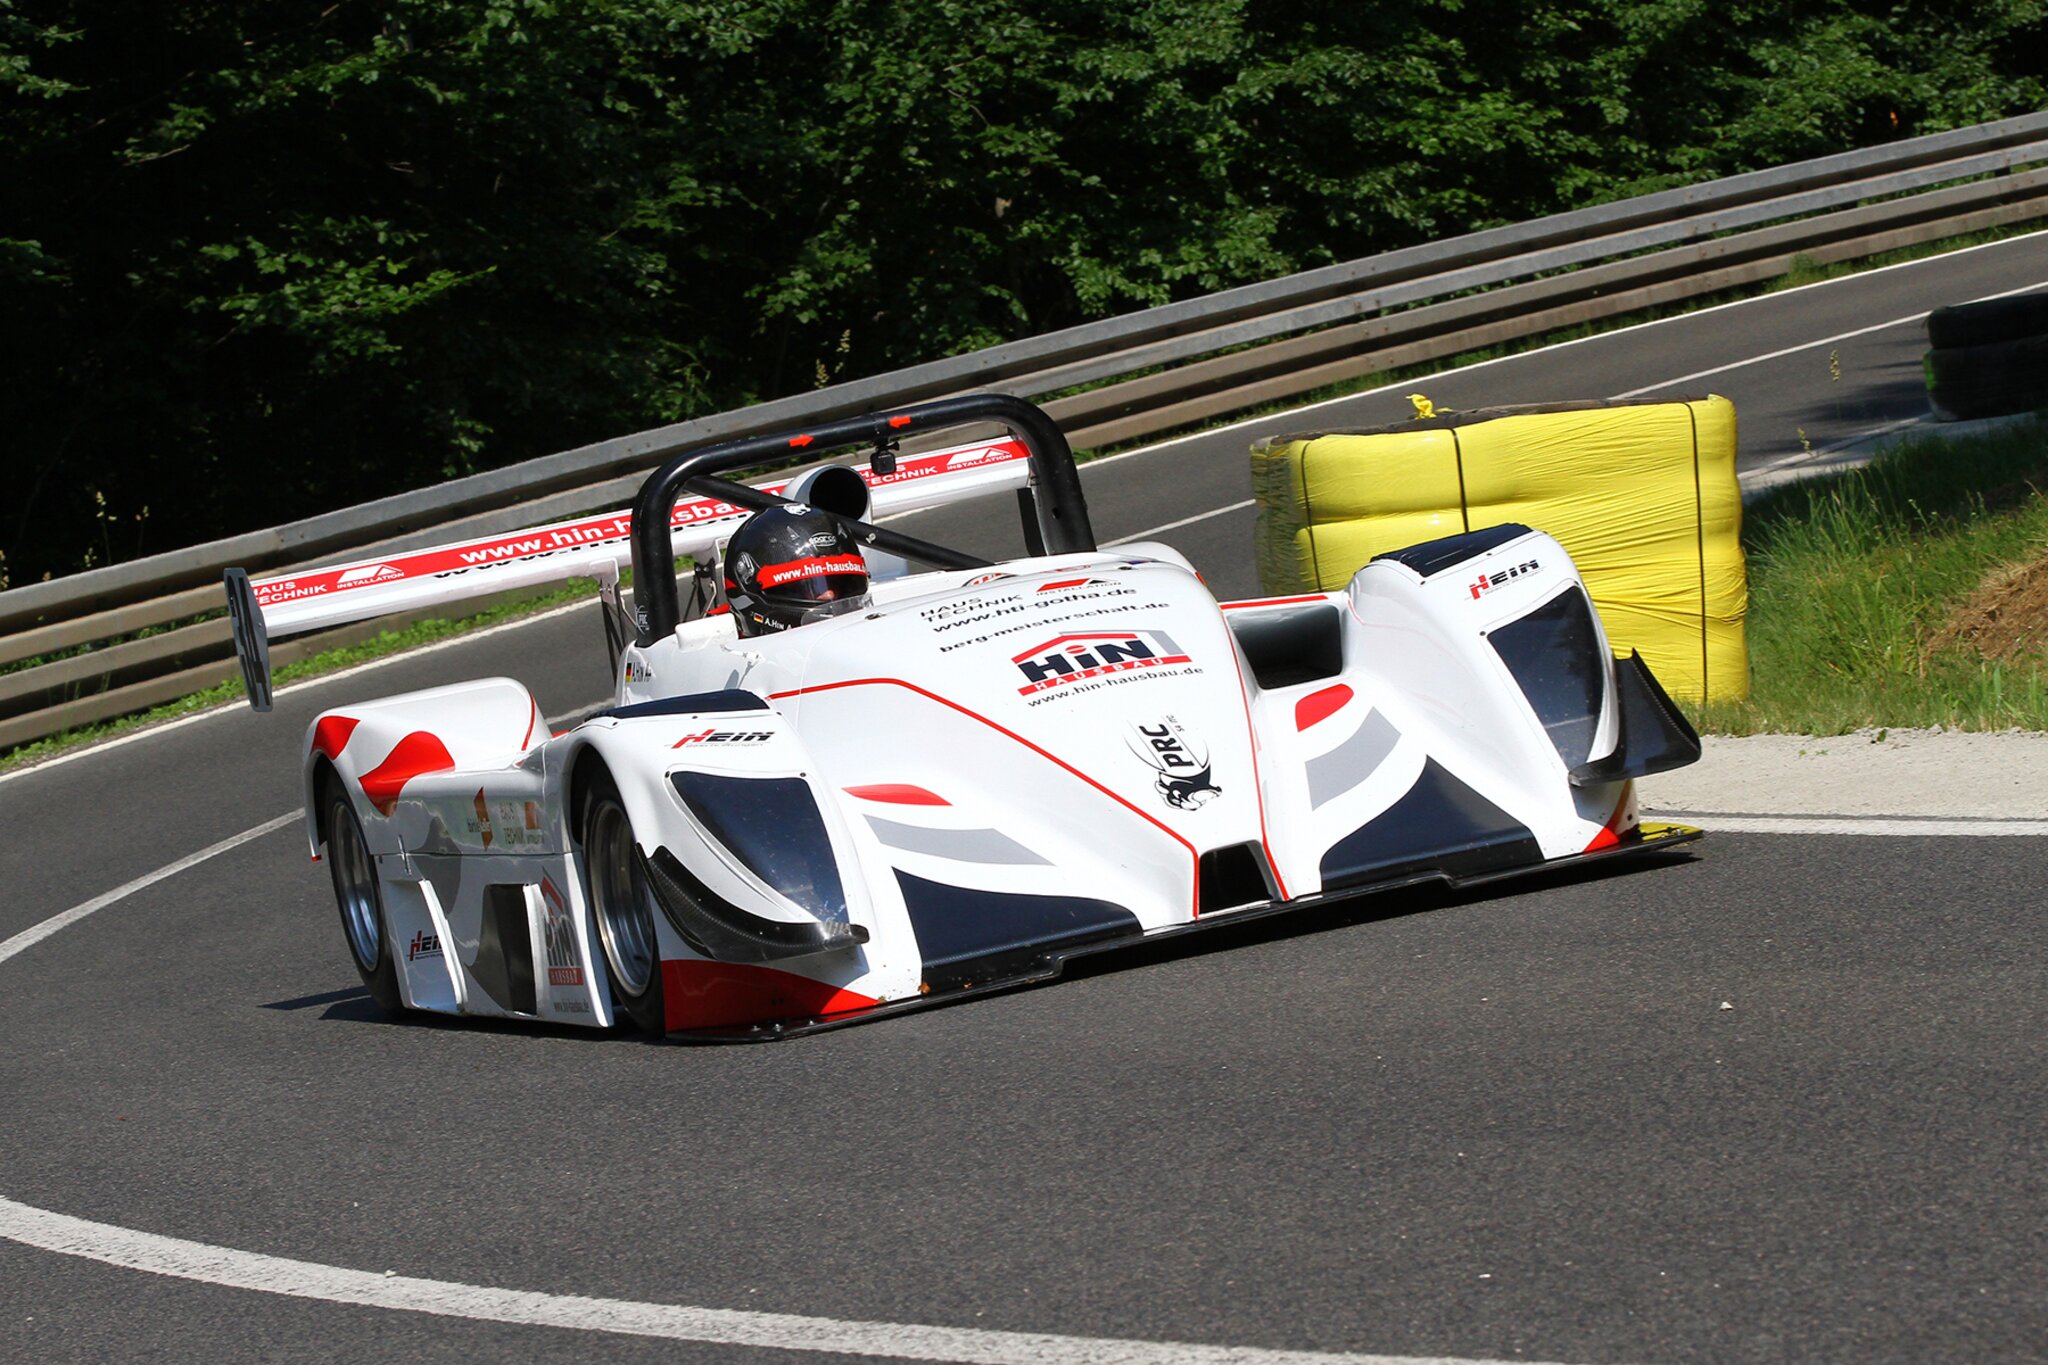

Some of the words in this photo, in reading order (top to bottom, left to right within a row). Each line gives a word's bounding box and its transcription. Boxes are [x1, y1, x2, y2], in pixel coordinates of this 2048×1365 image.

[946, 453, 1013, 471] INSTALLATION
[331, 571, 405, 590] INSTALLATION
[1036, 580, 1122, 596] INSTALLATION
[920, 597, 982, 618] HAUS
[924, 594, 1023, 623] TECHNIK
[932, 587, 1137, 633] www.hti-gotha.de
[939, 602, 1170, 653] berg-meisterschaft.de
[1027, 667, 1204, 708] www.hin-hausbau.de
[1034, 658, 1164, 691] HAUSBAU
[1138, 723, 1195, 768] PRC
